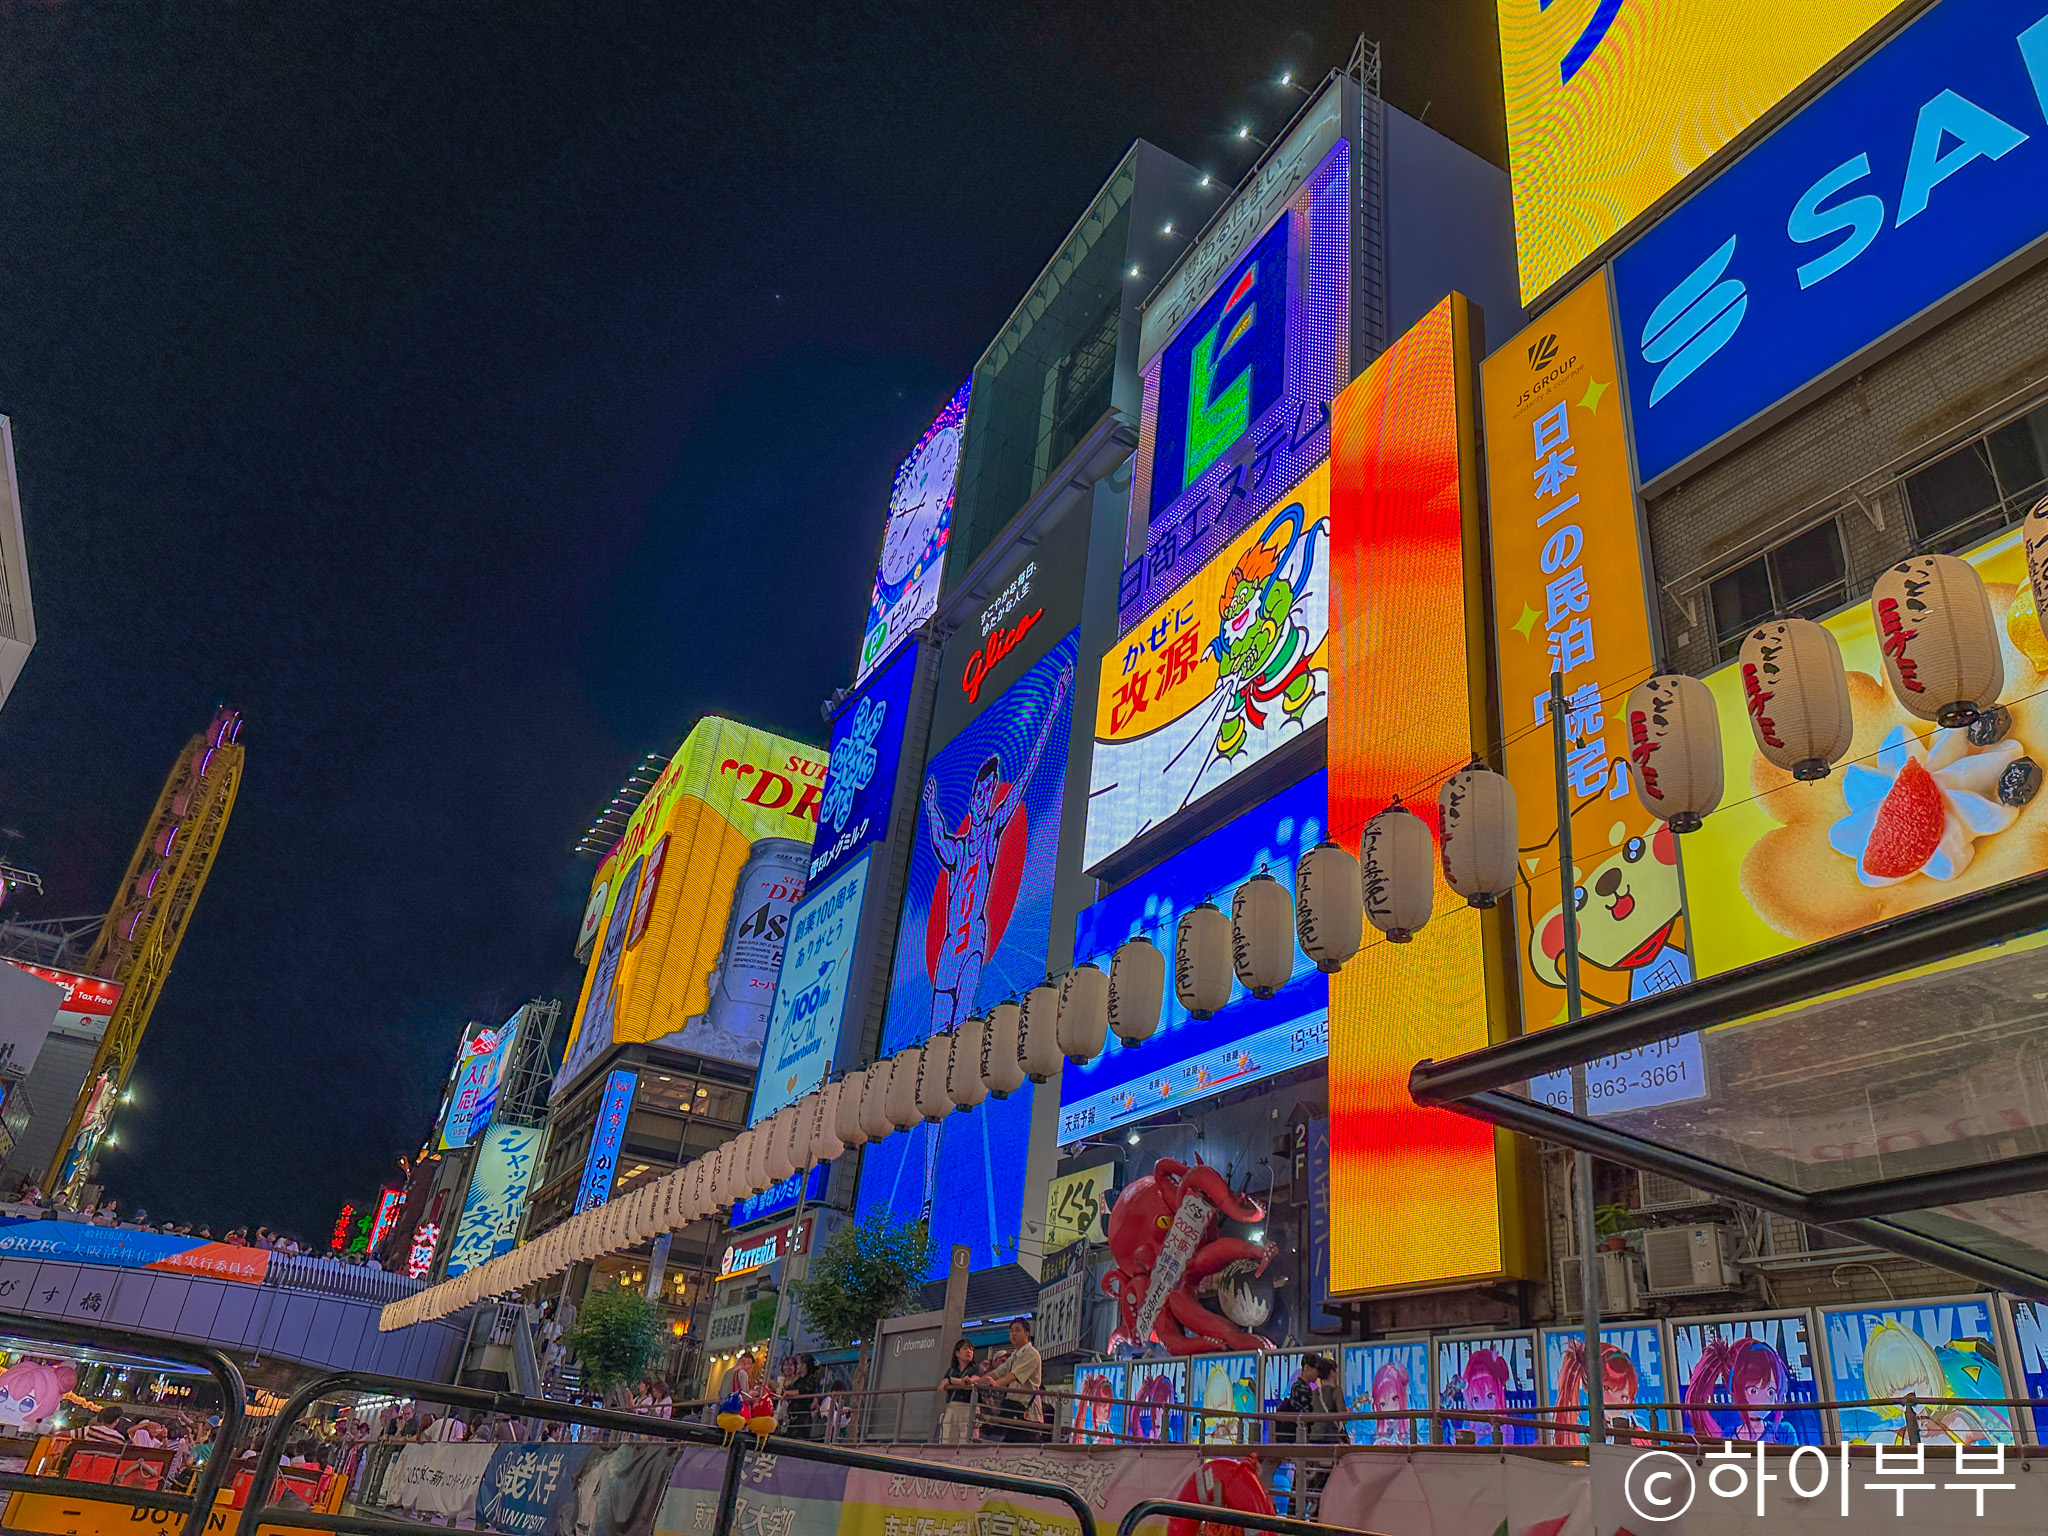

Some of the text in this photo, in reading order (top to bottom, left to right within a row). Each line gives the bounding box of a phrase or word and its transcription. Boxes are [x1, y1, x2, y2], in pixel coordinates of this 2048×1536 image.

[1787, 12, 2048, 290] SA
[1167, 158, 1302, 332] エステムシリーズ
[1512, 393, 1544, 420] solidarity
[1553, 364, 1585, 389] courage
[1516, 355, 1577, 407] JS GROUP
[1119, 400, 1330, 613] 日商エステム
[1533, 400, 1597, 675] 日本一の民泊
[889, 579, 925, 635] ピップ
[962, 607, 1044, 704] Glico
[1122, 598, 1194, 677] かぜに
[1877, 597, 1927, 694] ミナミ
[1110, 620, 1201, 736] 改源
[1741, 663, 1786, 749] ミナミ
[809, 817, 870, 882] 雪印メグミルク
[794, 879, 859, 945] 創業100周年
[955, 854, 982, 956] グリコ
[795, 918, 844, 970] ありがとう
[78, 991, 93, 1002] Tax
[94, 995, 113, 1006] Free
[777, 1036, 823, 1073] Anniversary
[603, 1096, 625, 1150] 本場の味
[1064, 1106, 1097, 1135] 天気予報
[732, 1241, 778, 1272] ZETTERIA
[1174, 1217, 1200, 1241] 2025
[903, 1336, 935, 1353] information
[130, 1504, 228, 1532] DOTN
